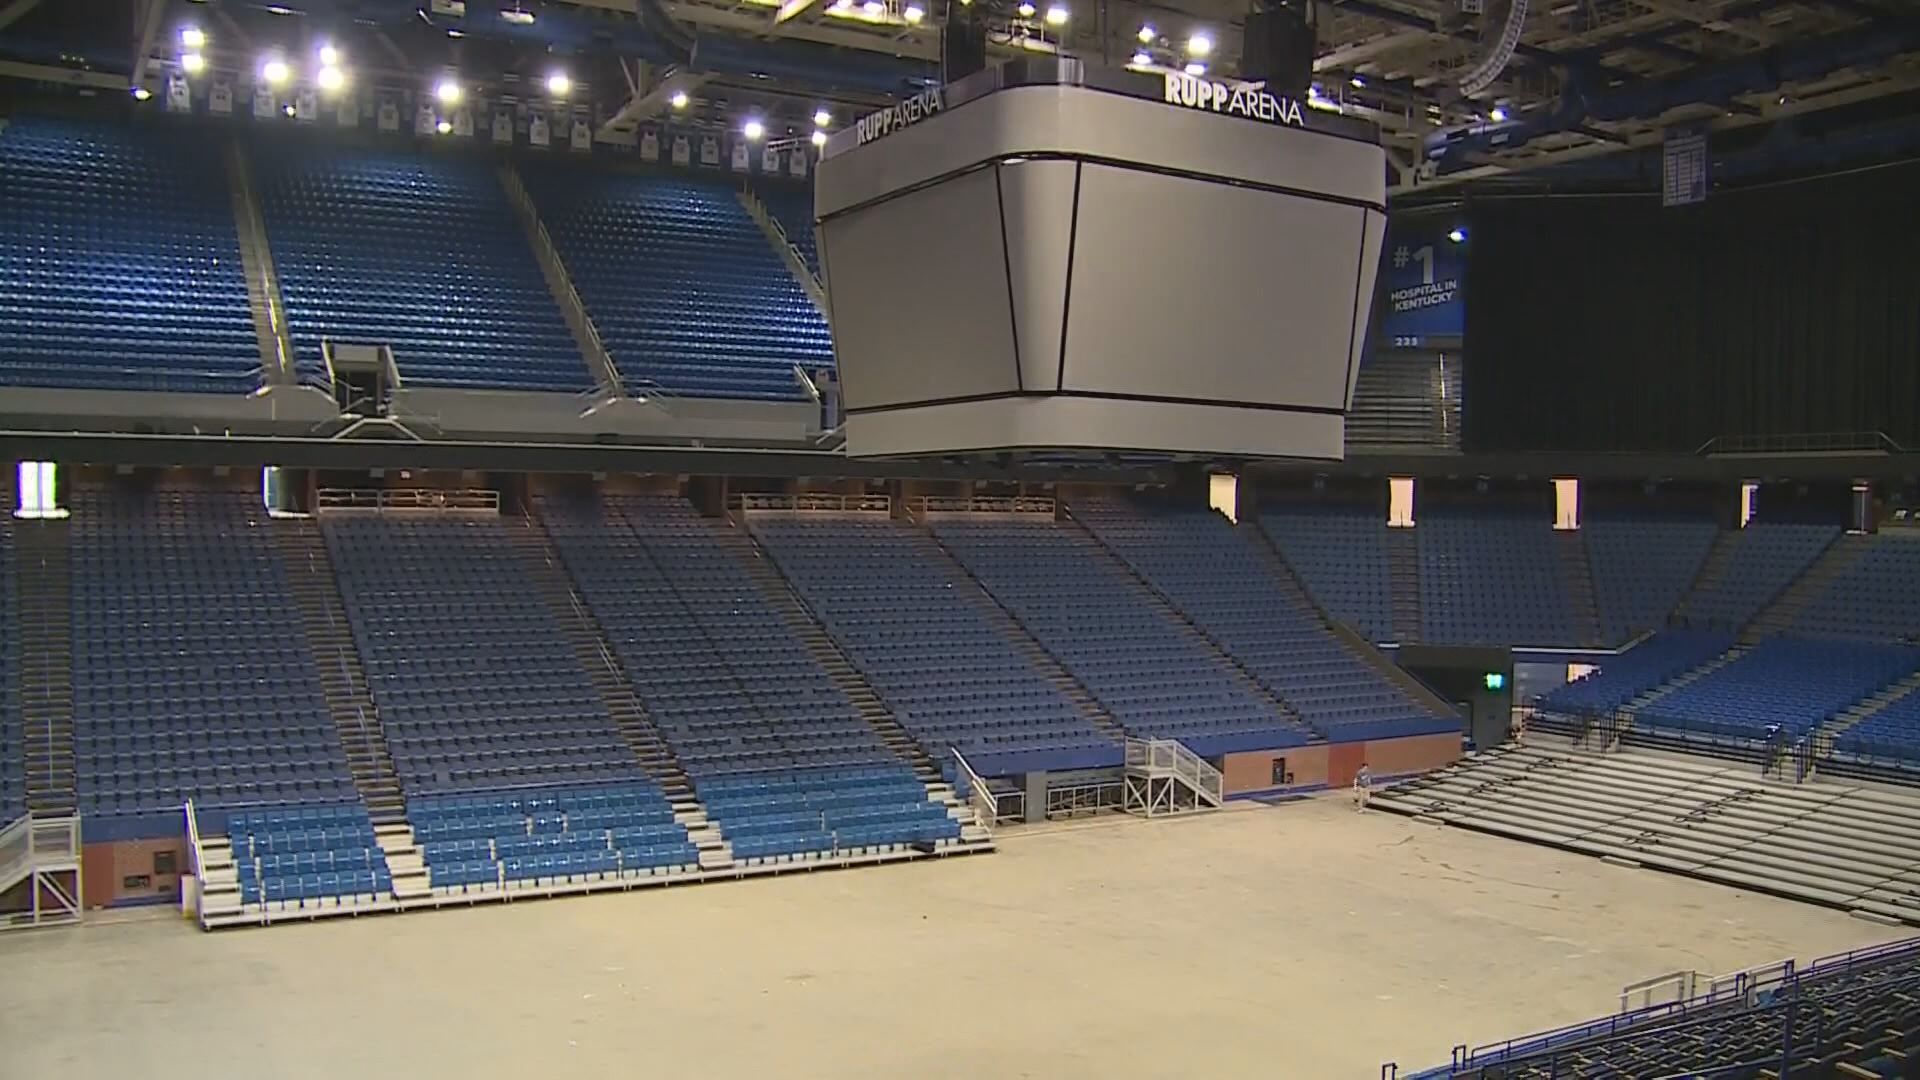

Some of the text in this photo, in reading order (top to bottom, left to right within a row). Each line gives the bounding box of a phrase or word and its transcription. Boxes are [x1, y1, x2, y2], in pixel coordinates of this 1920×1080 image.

[857, 87, 940, 145] RUPP ARENA
[1165, 73, 1305, 126] RUPP ARENA
[1393, 245, 1434, 284] #1
[1391, 280, 1457, 301] HOSPITAL IN
[1394, 292, 1453, 311] KENTUCKY
